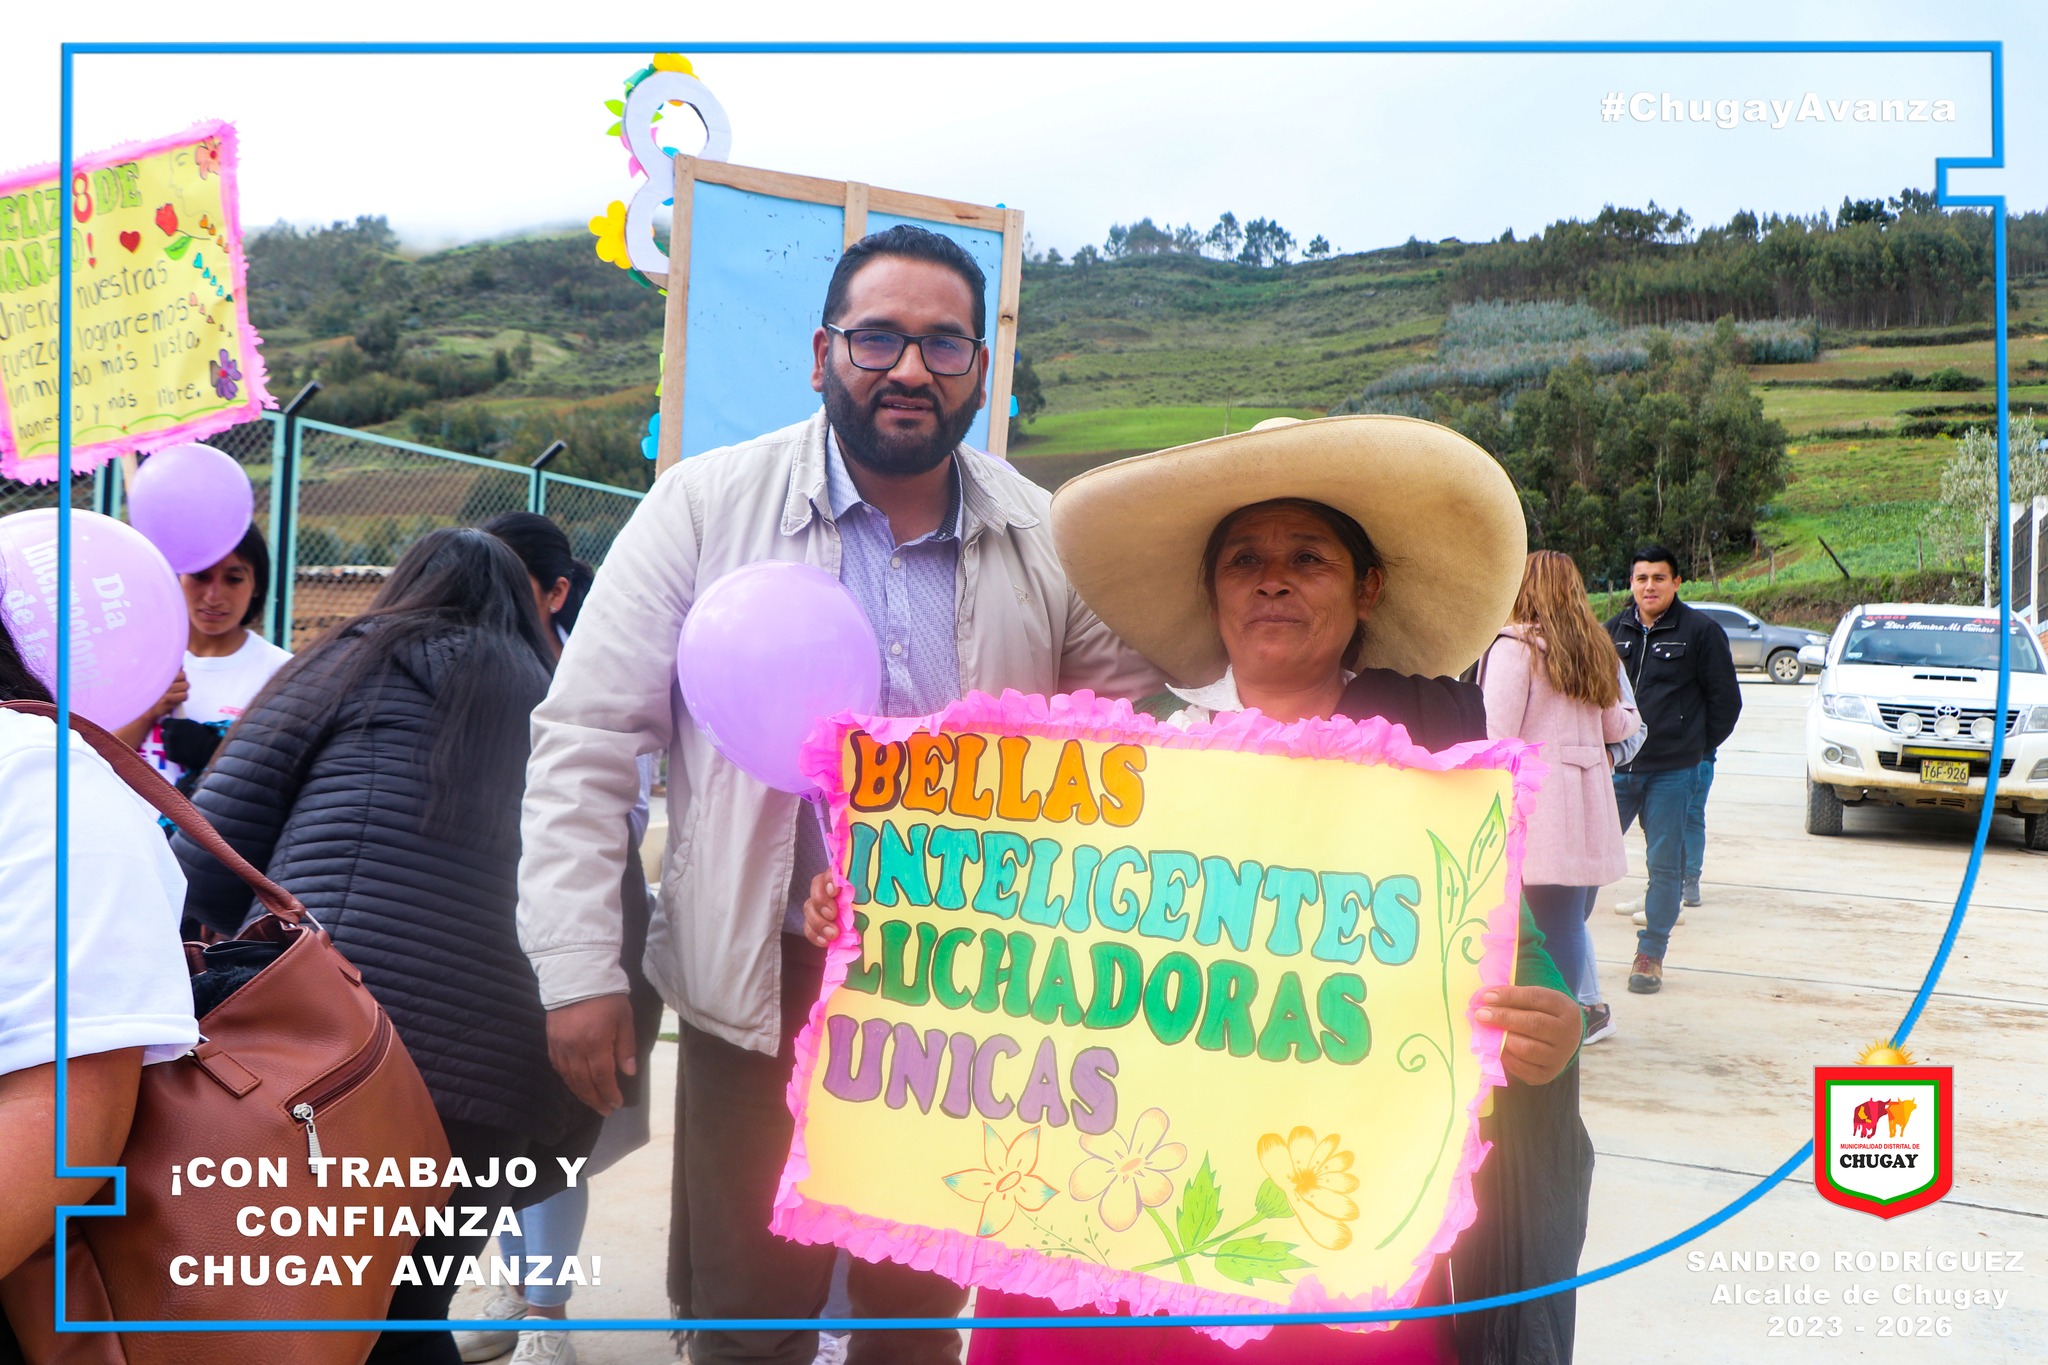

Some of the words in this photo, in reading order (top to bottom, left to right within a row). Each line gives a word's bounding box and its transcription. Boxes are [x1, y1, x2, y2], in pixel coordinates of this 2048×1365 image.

[72, 172, 93, 223] 8
[93, 162, 143, 215] DE
[0, 227, 97, 294] ARZO!
[76, 260, 168, 308] nuestras
[76, 298, 189, 351] lograremos
[33, 361, 92, 398] mudo
[157, 382, 201, 408] libre.
[6, 589, 38, 626] de
[91, 572, 132, 631] Día
[1883, 620, 1905, 630] Dios
[1962, 623, 1995, 633] Camino
[850, 730, 1147, 828] BELLAS
[1924, 765, 1966, 780] T6F-926
[848, 819, 1421, 966] INTELIGENTES
[841, 910, 1373, 1066] LUCHADORAS
[822, 1013, 1120, 1137] UNICAS
